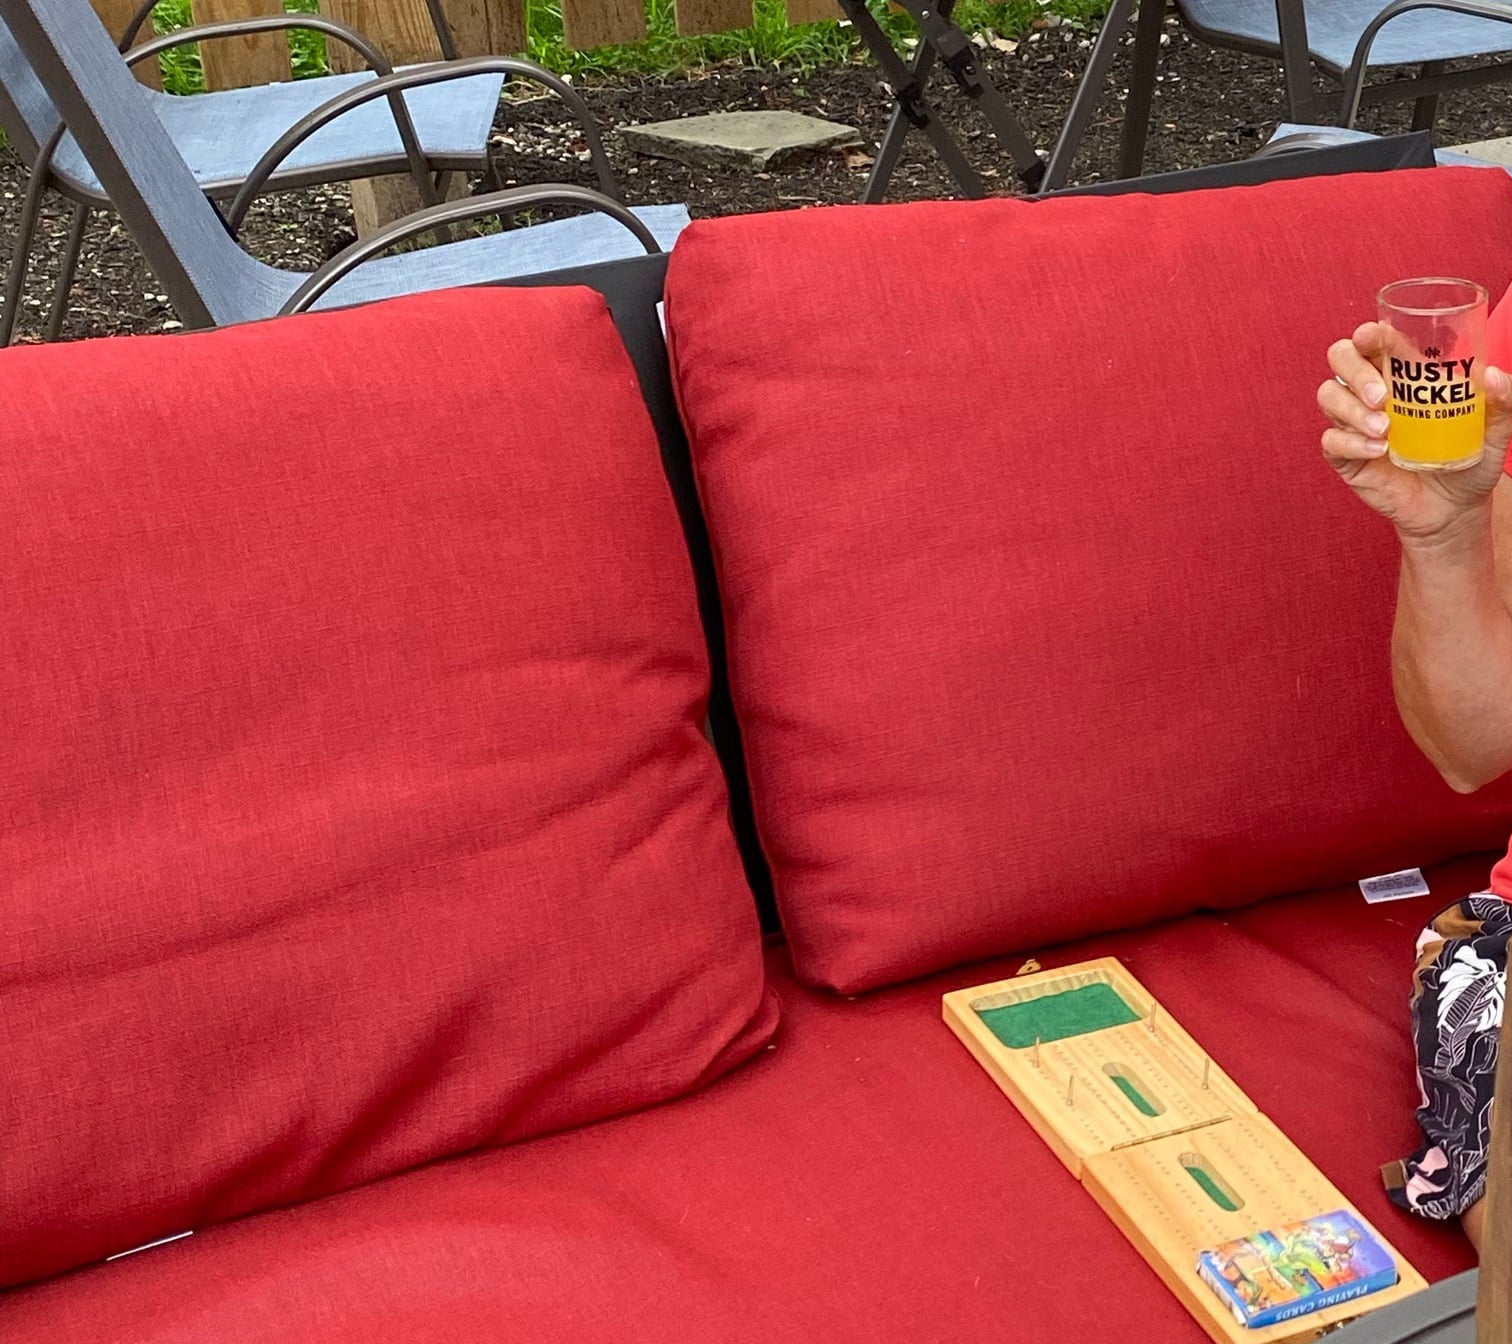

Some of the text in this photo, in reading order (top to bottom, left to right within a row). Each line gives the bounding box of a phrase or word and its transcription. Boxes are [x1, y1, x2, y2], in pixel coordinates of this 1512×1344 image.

[1390, 356, 1475, 383] RUSTY
[1391, 380, 1476, 405] NICKEL
[1392, 404, 1476, 420] BREWING COMPANY
[1275, 1283, 1370, 1322] PLAYING CARDS
